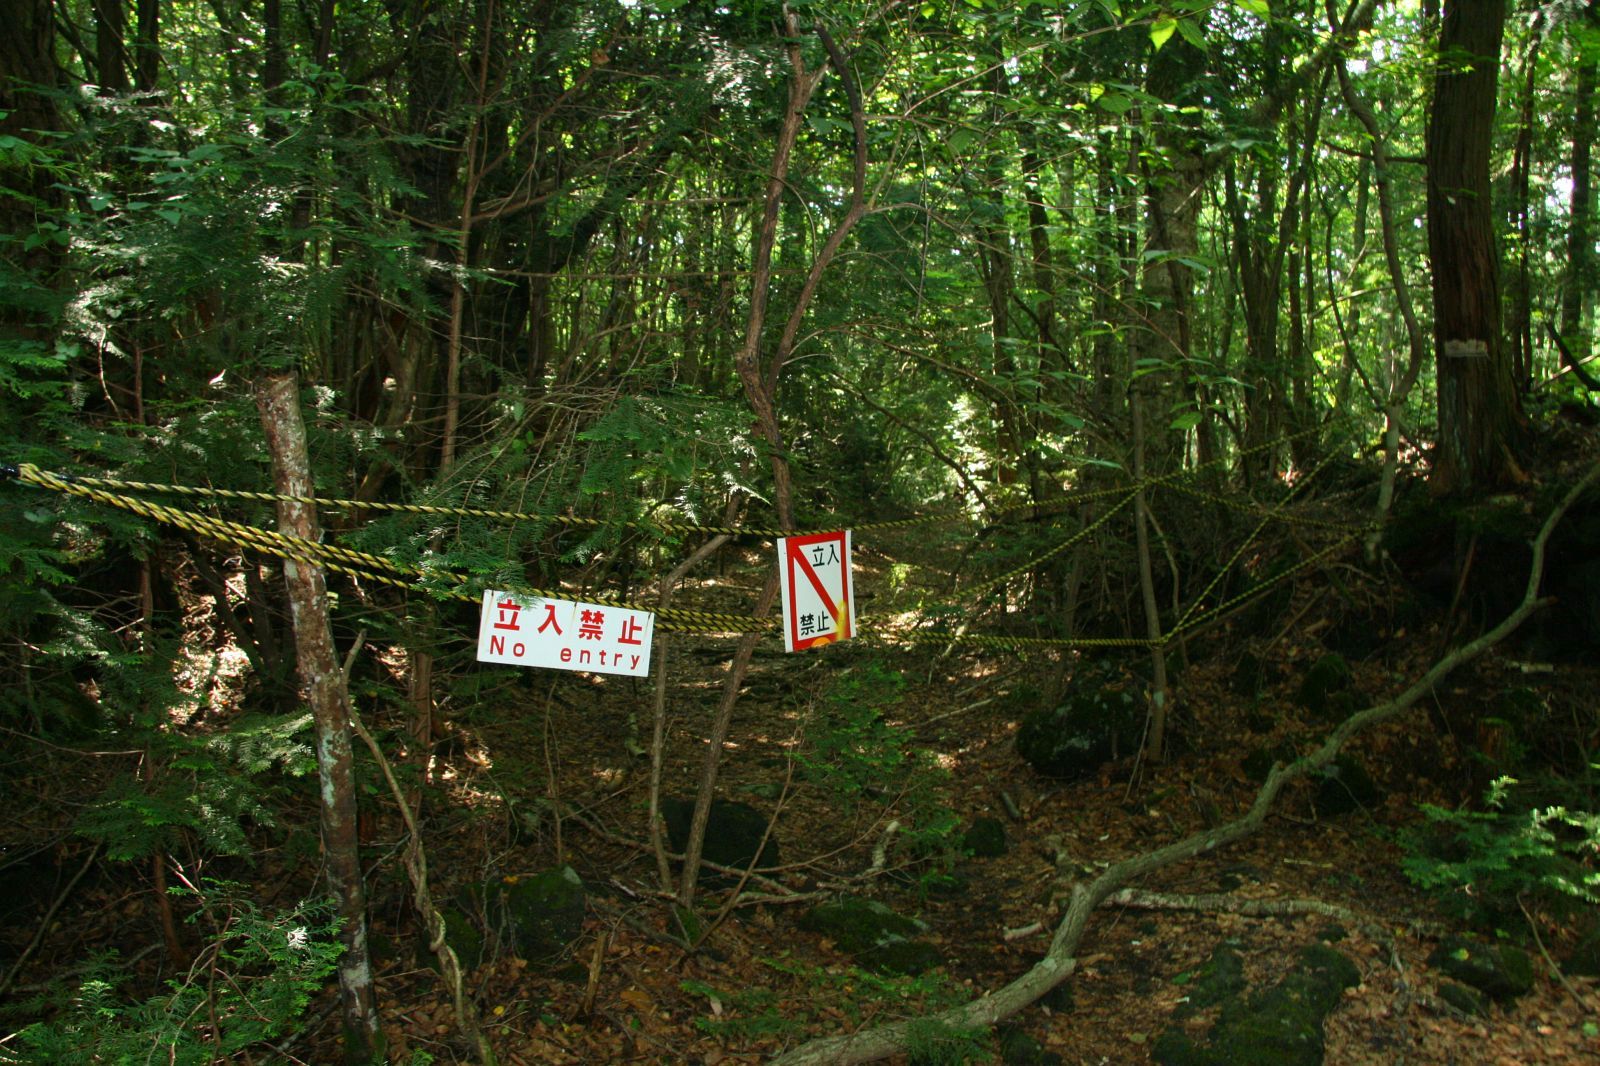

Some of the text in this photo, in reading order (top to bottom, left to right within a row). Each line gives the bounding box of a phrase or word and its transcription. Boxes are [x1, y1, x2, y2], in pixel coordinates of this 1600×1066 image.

[812, 544, 840, 567] 立入
[493, 599, 643, 646] 立入禁止
[800, 610, 830, 636] 禁止
[489, 634, 641, 670] No entry
